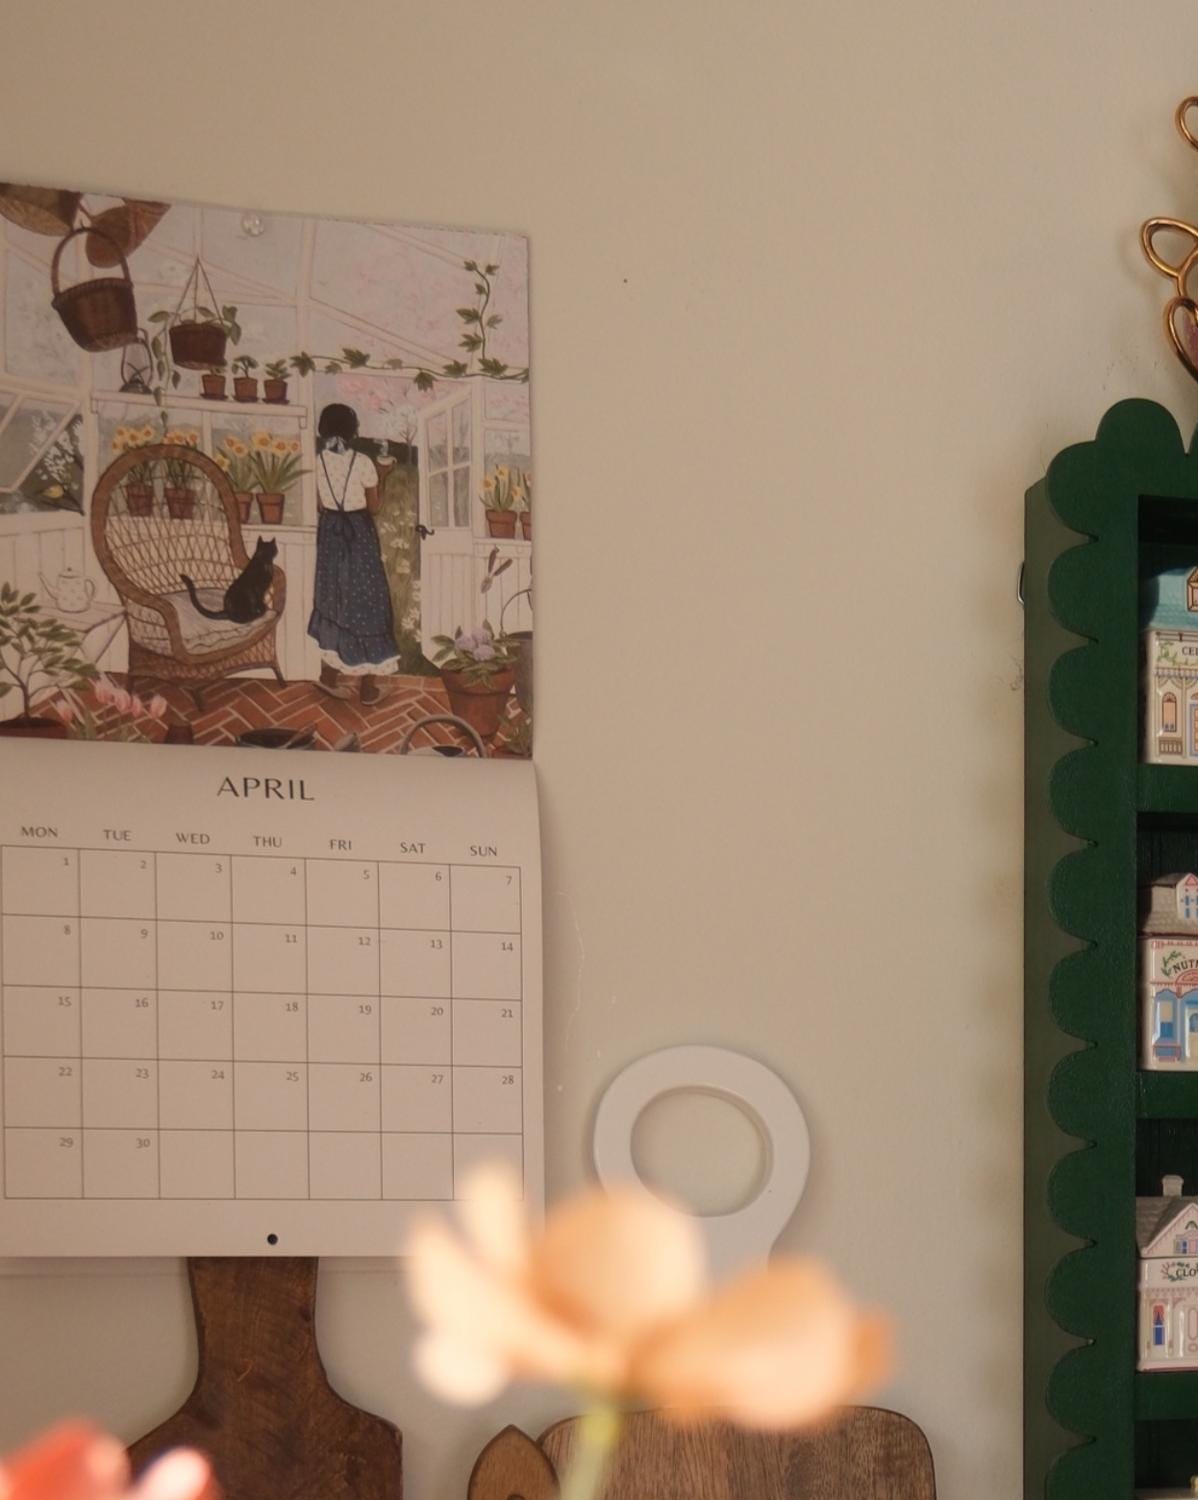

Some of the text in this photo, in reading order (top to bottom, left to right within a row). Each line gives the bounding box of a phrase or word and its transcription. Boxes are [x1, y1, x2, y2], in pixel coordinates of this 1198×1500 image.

[217, 776, 315, 801] APRIL
[21, 826, 498, 856] MON TUE WED THU FRI SAT SUN
[64, 857, 512, 886] 1 2 3 4 5 6 7
[64, 925, 513, 951] 8 9 10 11 12 13 14
[58, 997, 513, 1018] 15 16 17 18 19 20 21
[58, 1067, 514, 1084] 22 23 24 25 26 27 28
[59, 1138, 150, 1148] 29 30
